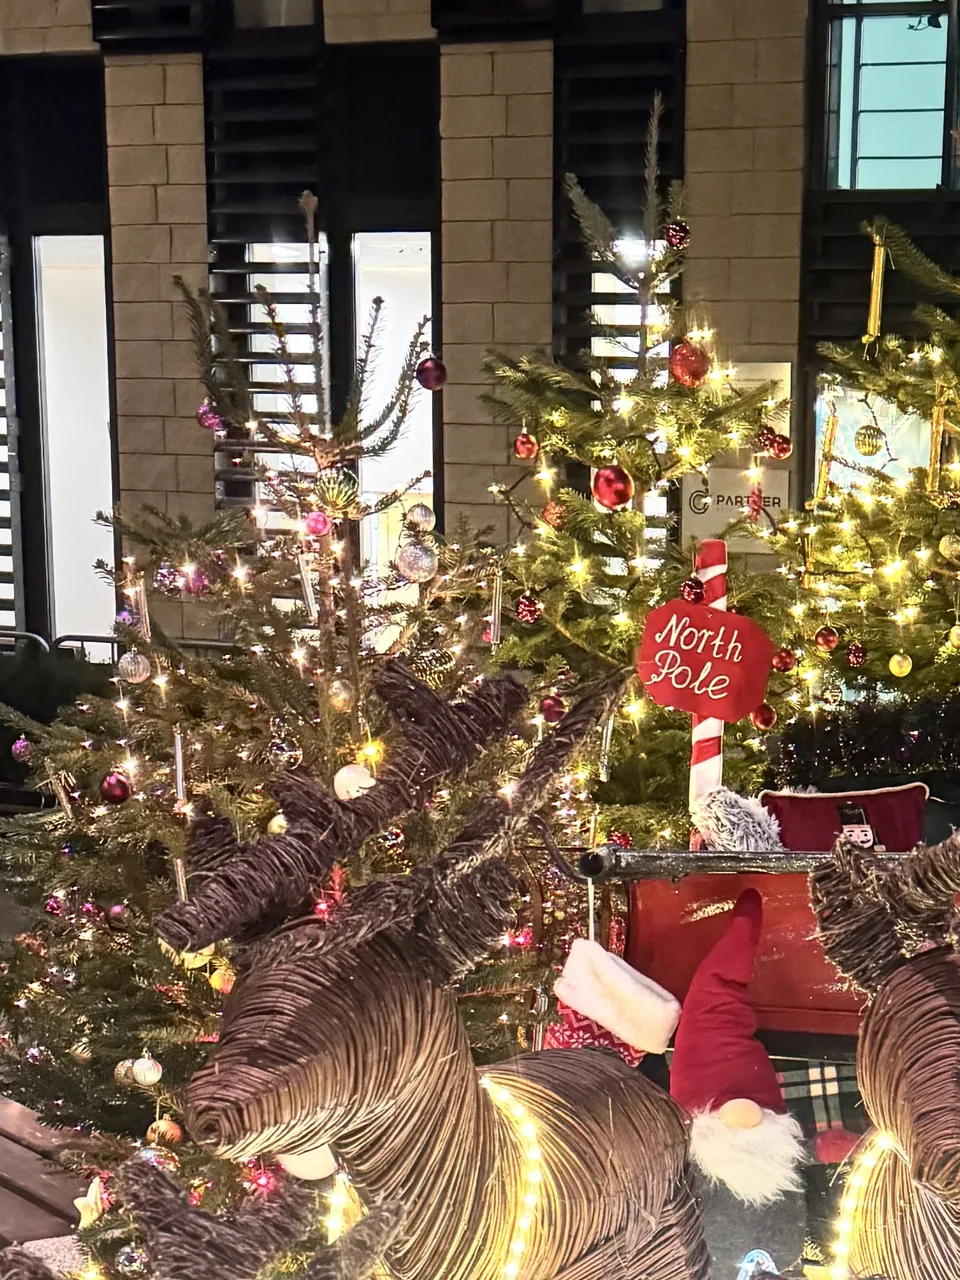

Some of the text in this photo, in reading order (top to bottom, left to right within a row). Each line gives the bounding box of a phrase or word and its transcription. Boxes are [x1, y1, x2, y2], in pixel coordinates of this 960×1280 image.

[716, 495, 781, 508] PARTER
[655, 614, 743, 663] North
[645, 649, 731, 700] Pole
